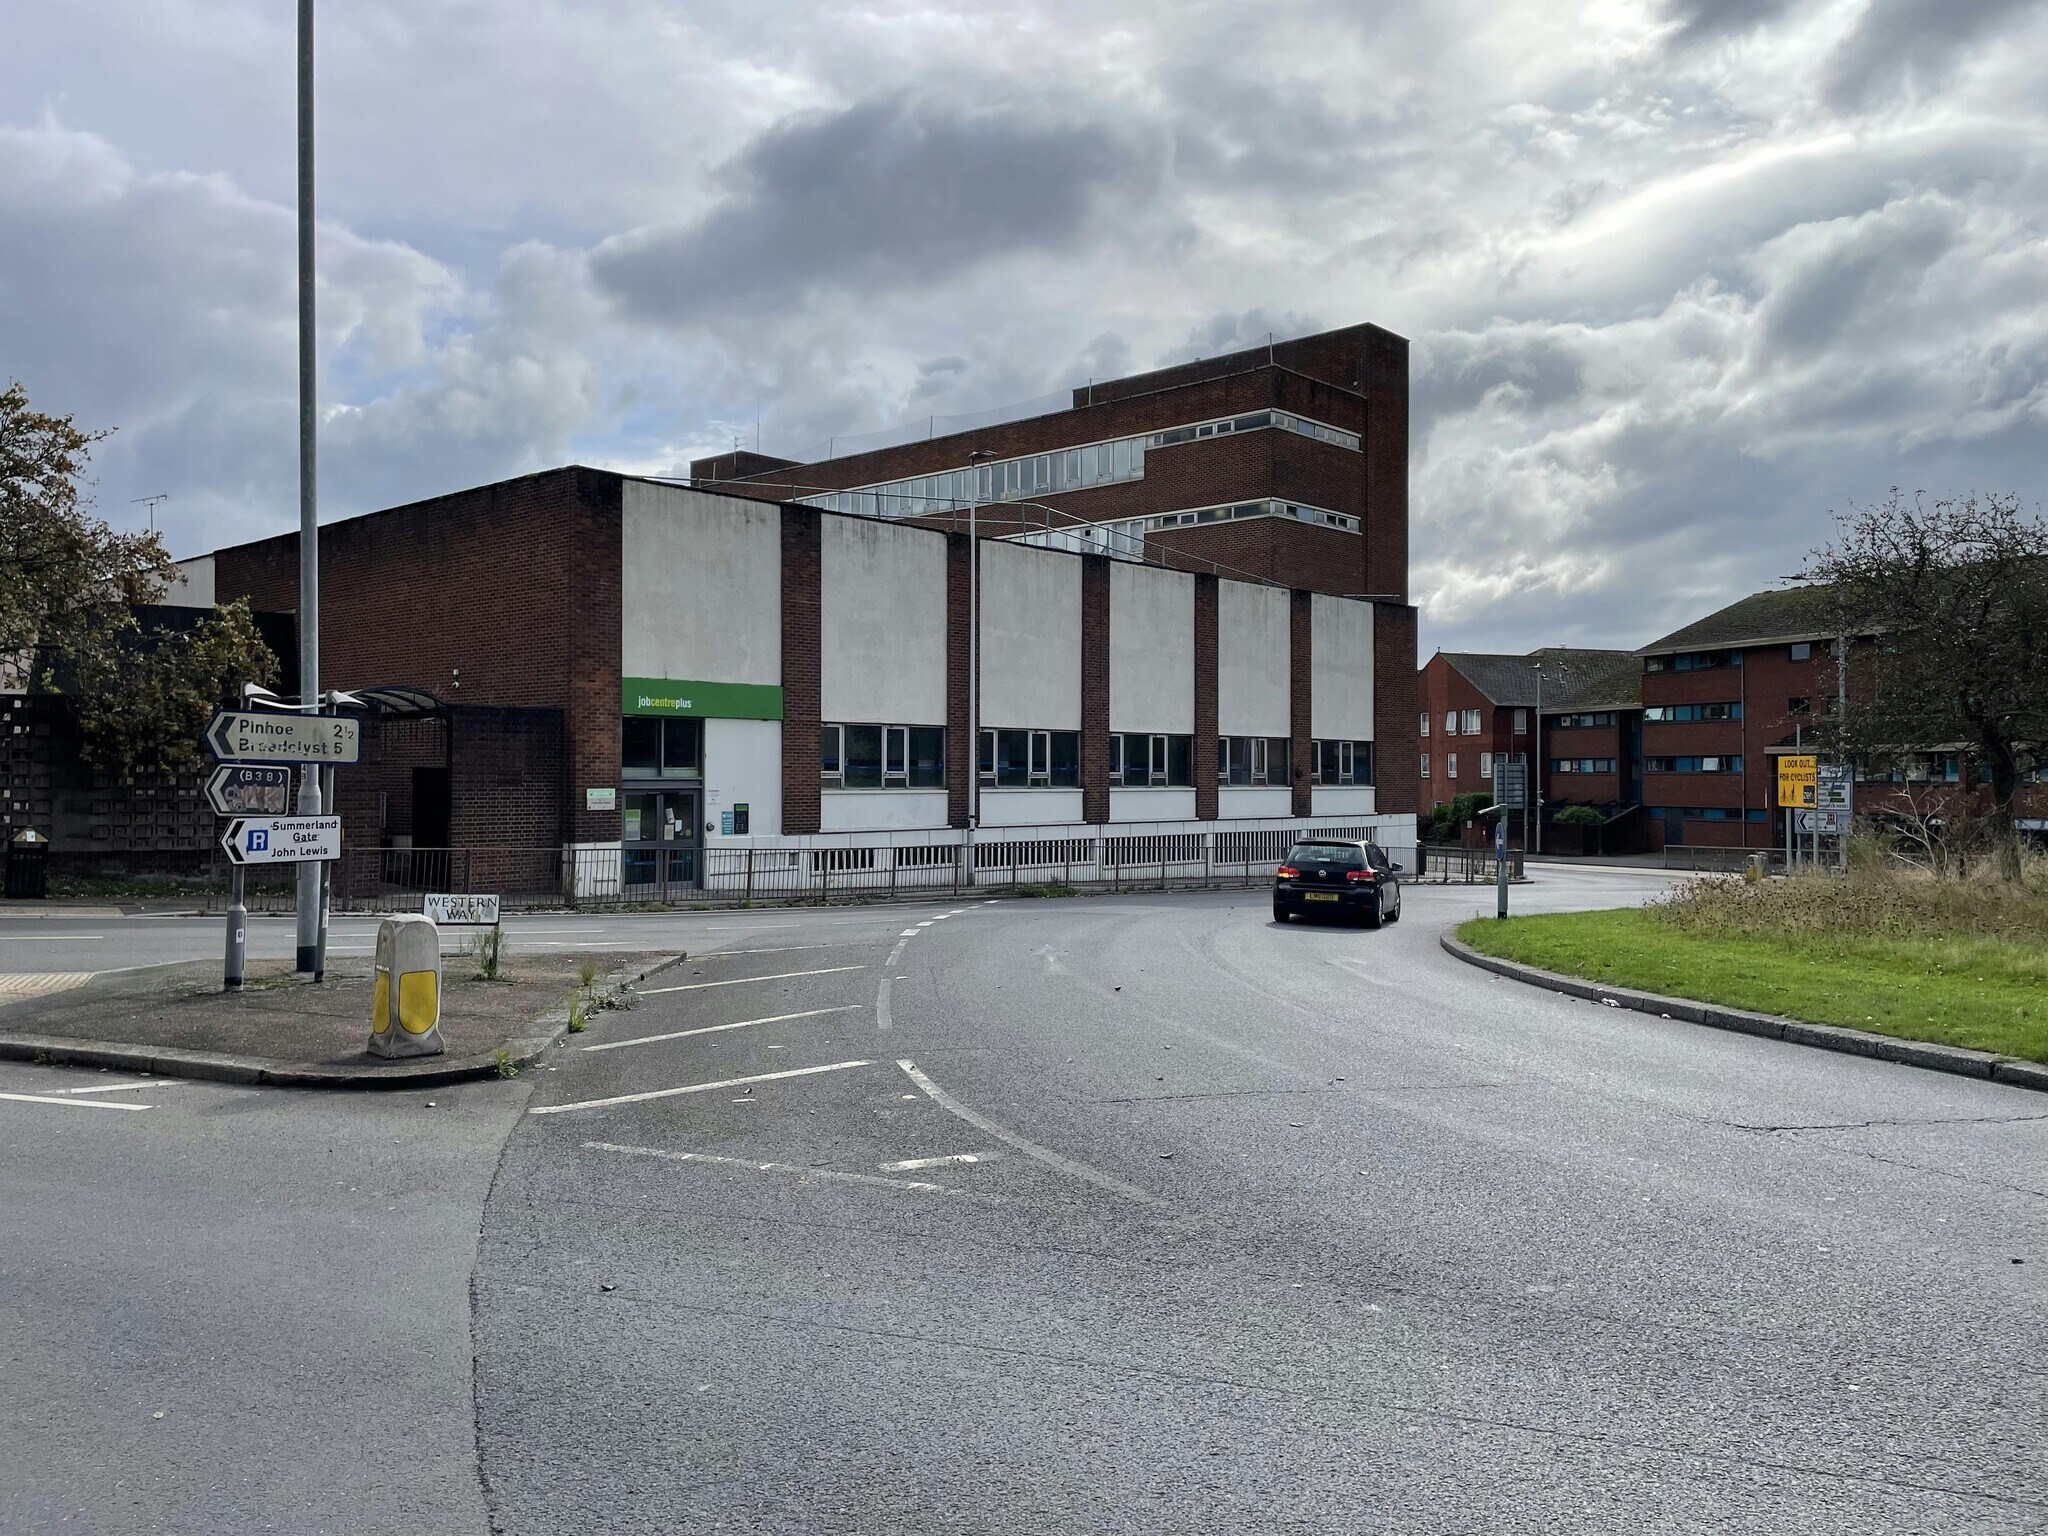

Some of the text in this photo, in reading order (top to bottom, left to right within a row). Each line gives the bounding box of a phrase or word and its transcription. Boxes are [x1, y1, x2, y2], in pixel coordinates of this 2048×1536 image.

[638, 695, 692, 710] jobcentreplus
[239, 719, 294, 735] Pinhoe
[334, 742, 343, 754] 5
[1784, 759, 1797, 768] LOOK
[1780, 773, 1815, 781] FOR CYCLISTS
[272, 820, 337, 831] Summerland
[292, 832, 318, 842] Gate
[271, 846, 328, 857] John Lewis
[428, 897, 497, 907] WESTERN
[446, 910, 476, 920] WAY
